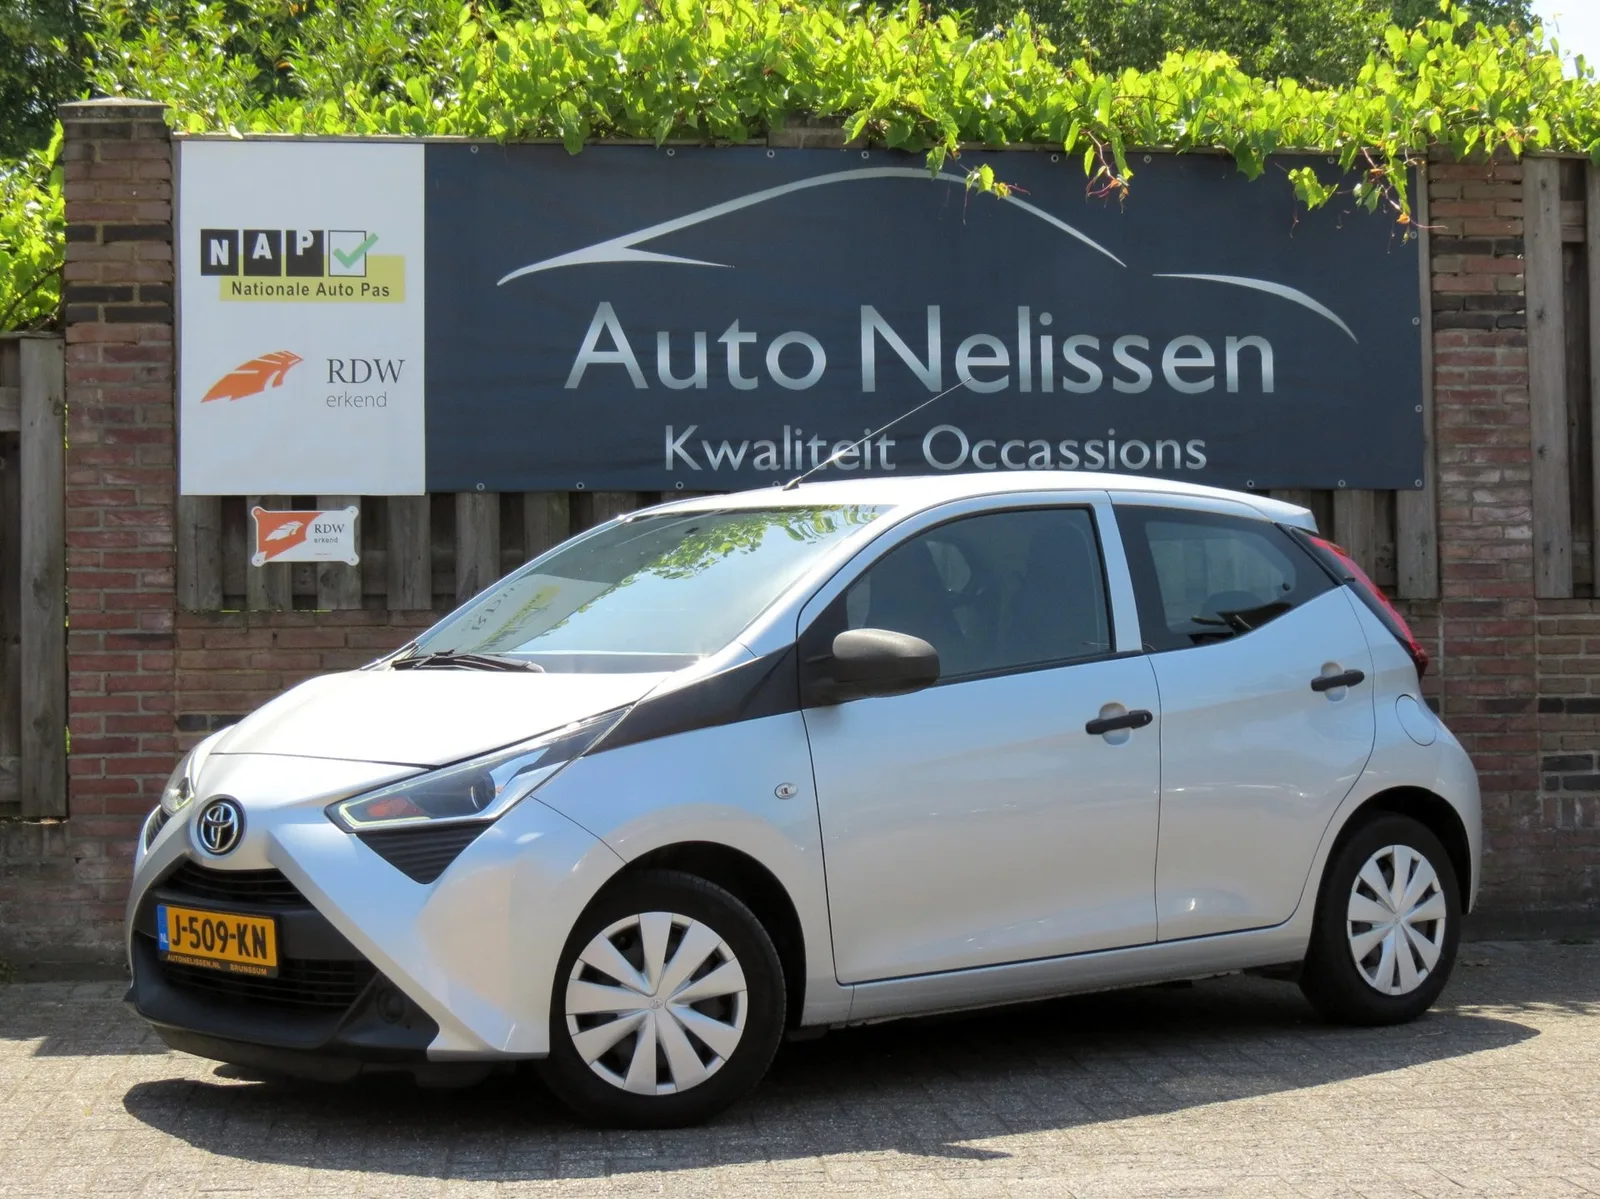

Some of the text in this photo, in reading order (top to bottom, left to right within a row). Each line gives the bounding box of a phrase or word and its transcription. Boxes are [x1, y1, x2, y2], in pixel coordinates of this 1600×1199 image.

[210, 230, 315, 266] NAP
[231, 281, 390, 297] Nationale Auto Pas
[563, 301, 1275, 394] Auto Nelissen
[326, 358, 406, 384] RDW
[326, 391, 387, 408] erkend
[664, 424, 1207, 473] Kwaliteit Occassions
[314, 523, 345, 534] RDW
[172, 914, 268, 960] J-509-KN
[229, 963, 268, 976] BRUNSSUM
